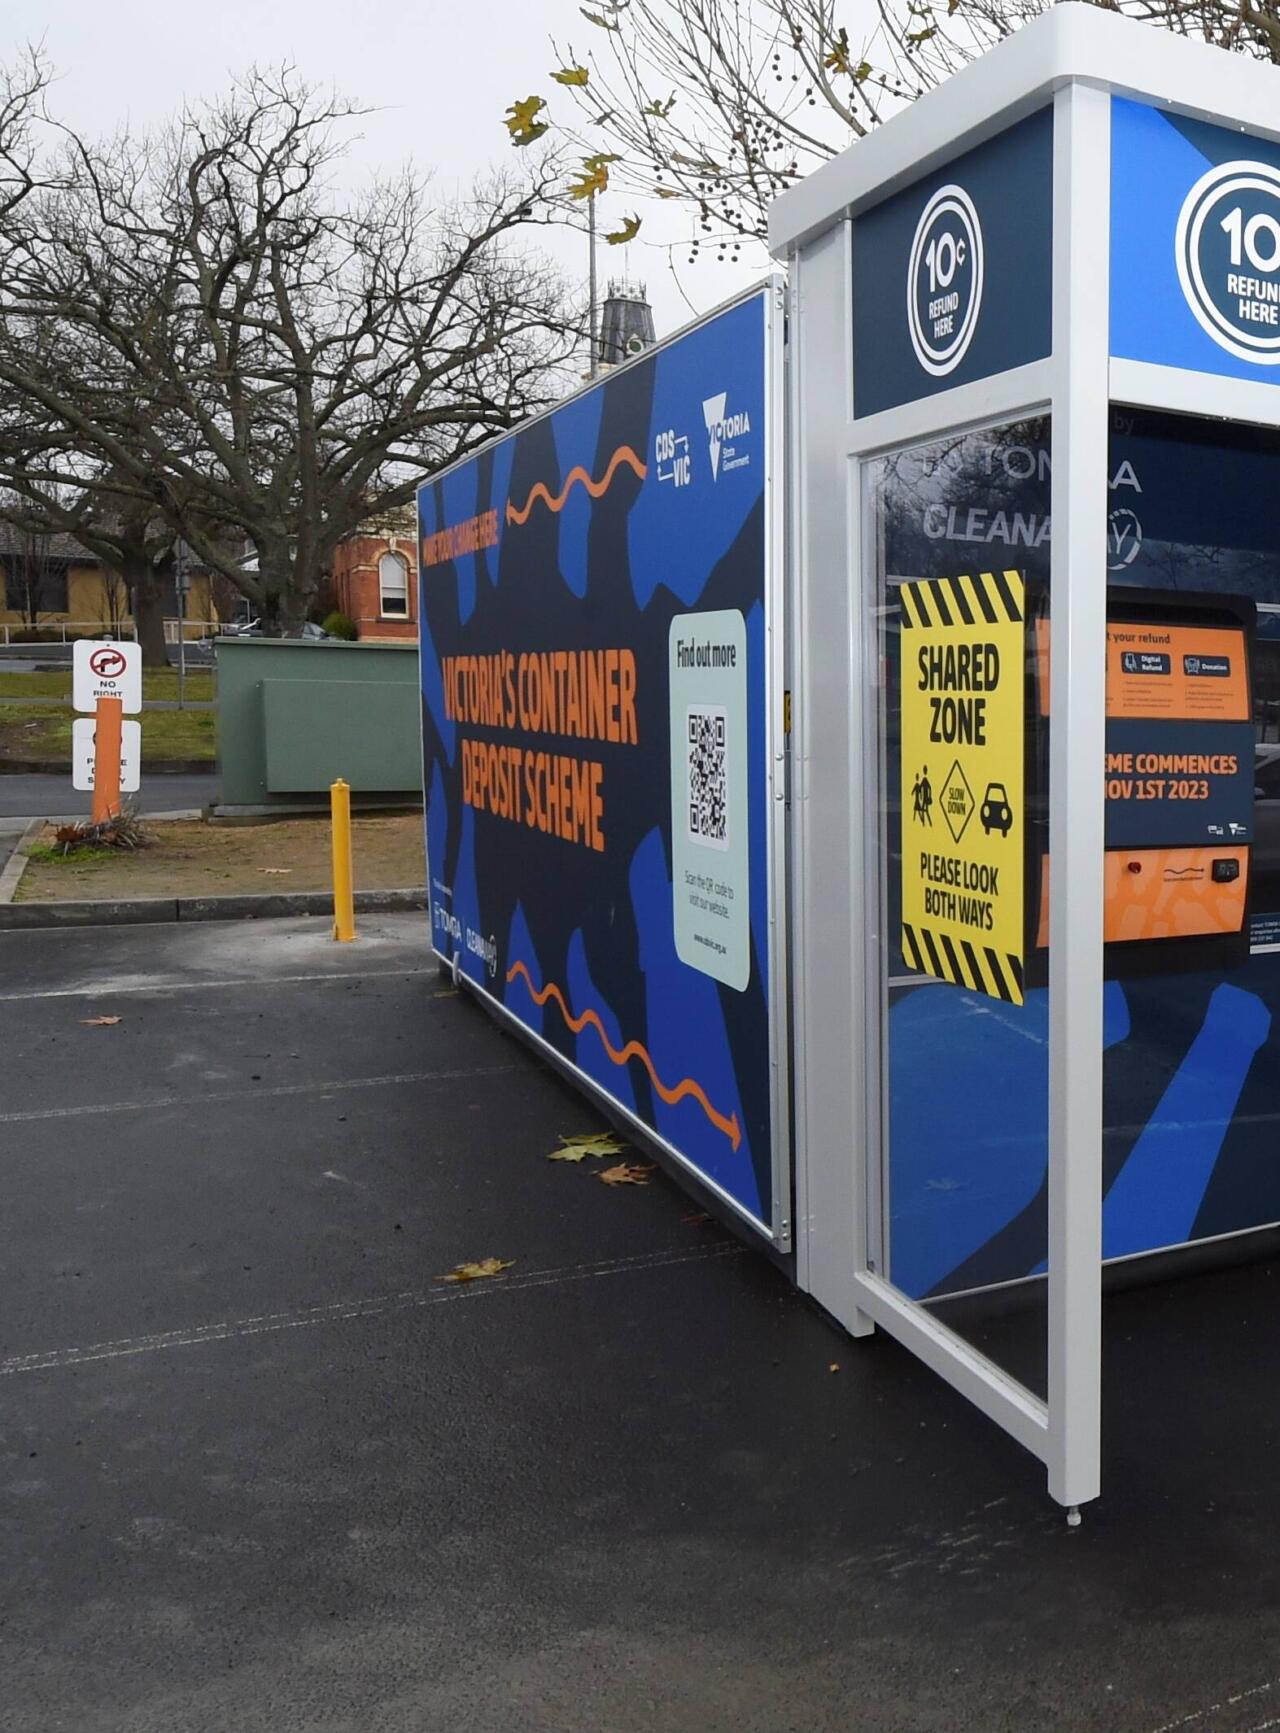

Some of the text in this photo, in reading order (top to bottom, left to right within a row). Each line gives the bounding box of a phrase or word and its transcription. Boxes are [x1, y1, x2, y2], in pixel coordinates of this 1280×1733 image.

[925, 232, 966, 292] 10¢
[929, 292, 959, 320] REFUND
[1239, 299, 1279, 325] HERE
[934, 315, 954, 339] HERE
[708, 411, 750, 444] VICTORIA
[656, 429, 675, 463] CDS
[673, 455, 690, 487] VIC
[677, 637, 736, 668] Find out more
[1113, 633, 1171, 644] your refund
[918, 643, 1000, 692] SHARED
[1141, 656, 1161, 664] Digital
[100, 680, 116, 688] NO
[443, 648, 638, 745] VICTORIA'S CONTAINER
[930, 697, 986, 746] ZONE
[1136, 754, 1238, 775] COMMENCES
[461, 739, 605, 853] DEPOSIT SCHEME
[948, 787, 965, 801] SLOW
[1104, 779, 1209, 800] OV 1ST 2023
[948, 800, 966, 816] DOWN
[920, 852, 999, 897] PLEASE LOOK
[925, 886, 993, 932] BOTH WAYS
